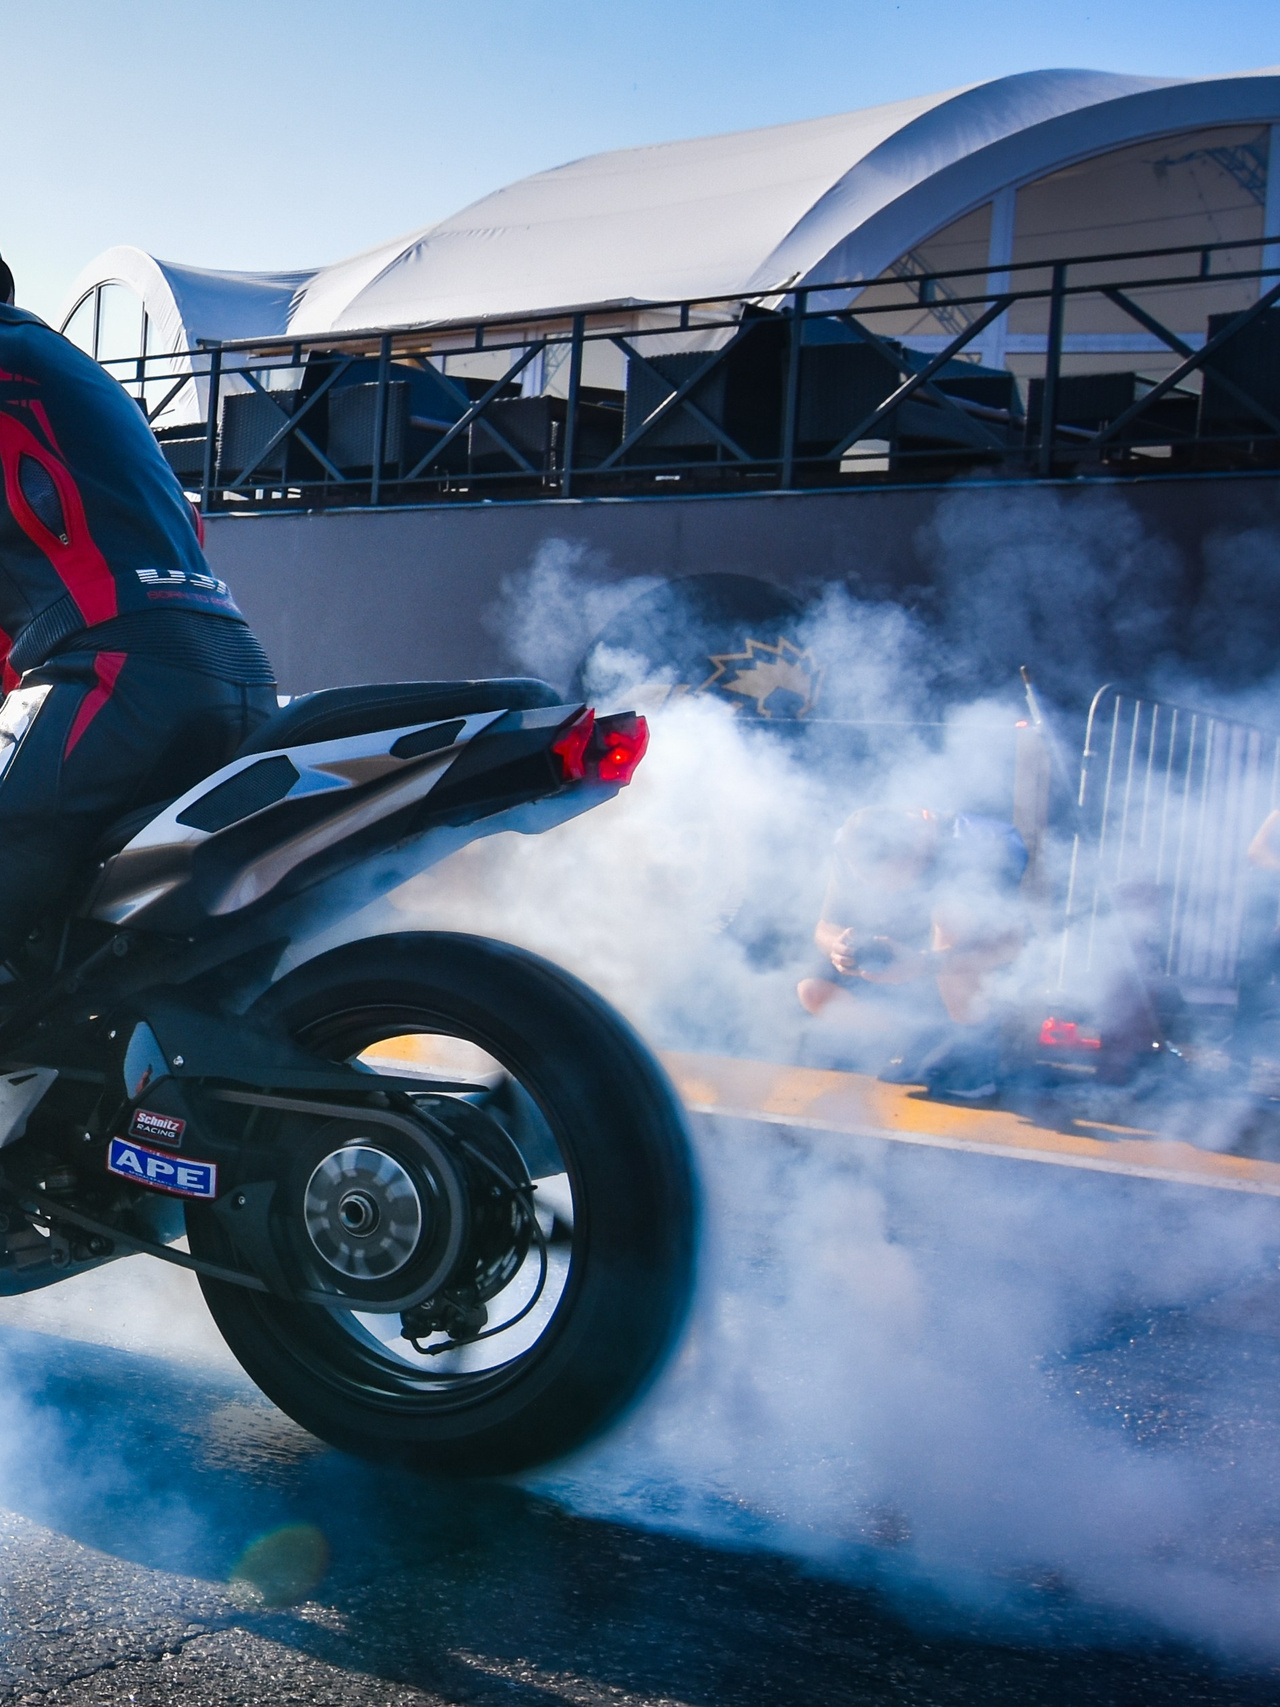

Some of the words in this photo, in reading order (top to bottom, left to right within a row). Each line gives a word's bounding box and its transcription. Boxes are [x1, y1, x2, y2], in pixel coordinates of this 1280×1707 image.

[136, 1124, 175, 1138] RACING
[137, 1113, 180, 1131] Schnitz
[116, 1149, 205, 1189] APE
